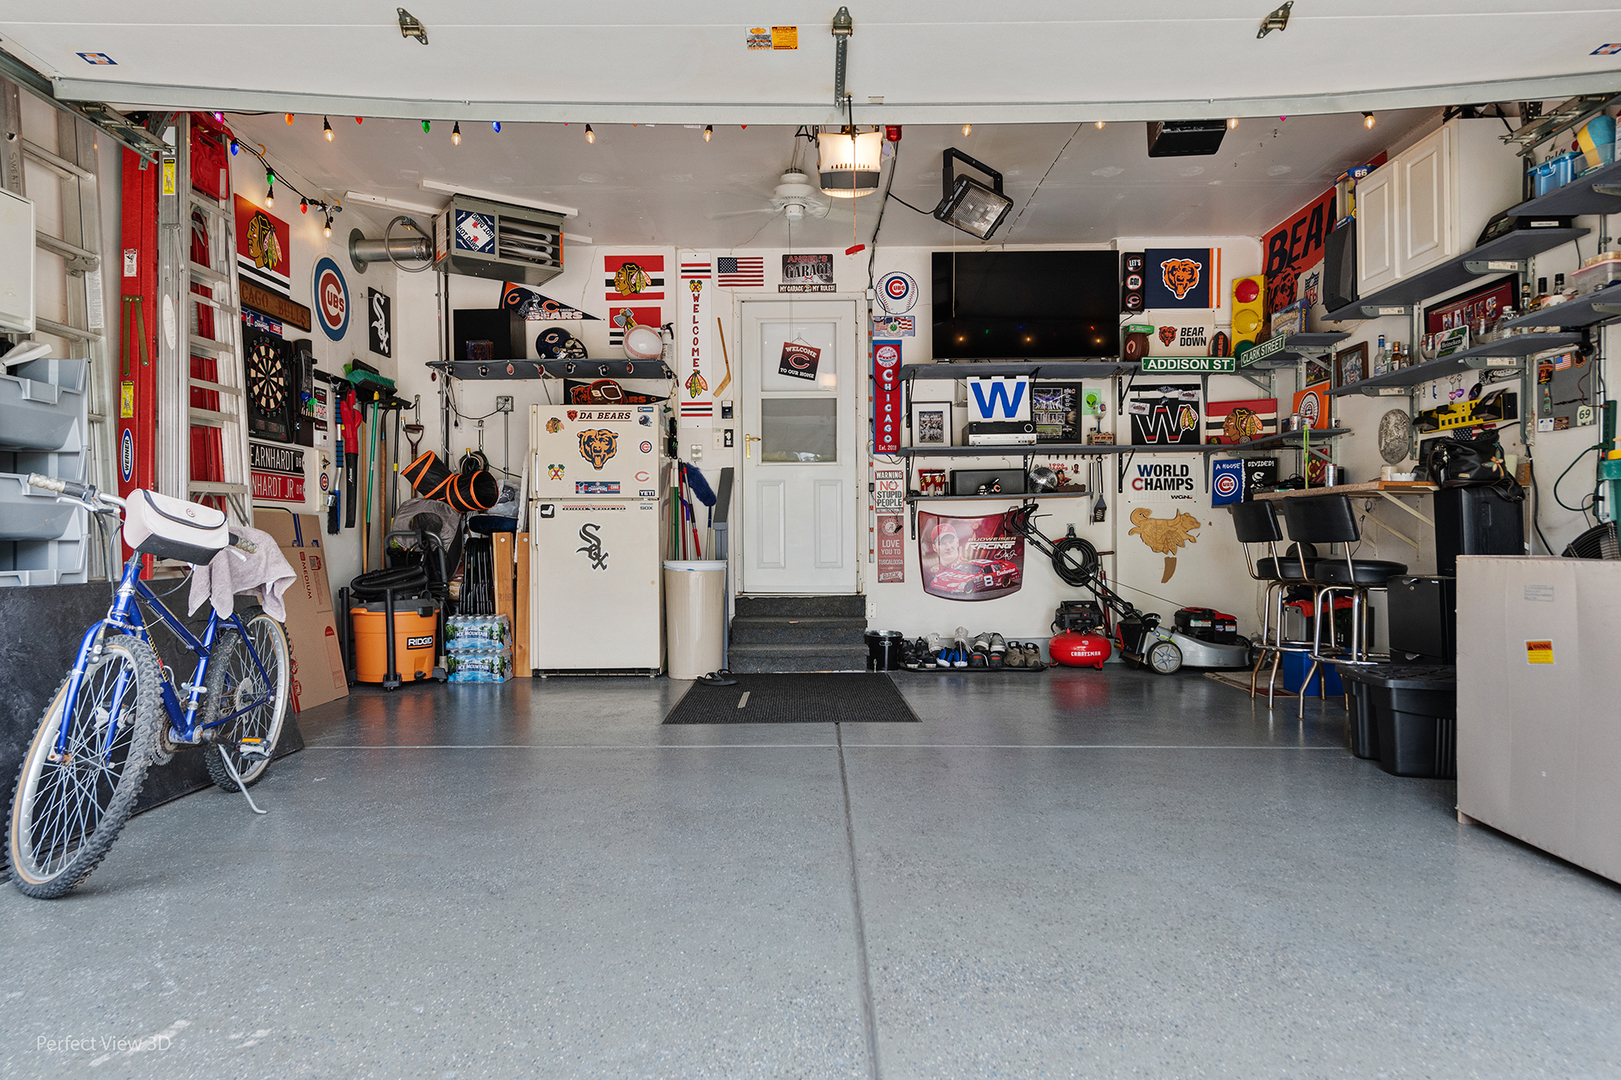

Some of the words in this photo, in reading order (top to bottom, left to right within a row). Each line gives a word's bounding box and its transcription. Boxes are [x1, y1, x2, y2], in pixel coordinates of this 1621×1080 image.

[1355, 169, 1368, 177] 66
[457, 226, 469, 238] HOT
[787, 255, 828, 263] ANGEL'S
[1129, 259, 1141, 267] LET'S
[785, 263, 832, 279] GARAGE
[1129, 278, 1140, 286] GO!
[278, 300, 307, 328] BULLS
[692, 294, 700, 367] WELCOME
[1180, 327, 1205, 336] BEAR
[1180, 337, 1207, 347] DOWN
[785, 347, 817, 358] WELCOME
[1242, 346, 1261, 364] CLARK
[1261, 337, 1283, 356] STREET
[1147, 360, 1210, 370] ADDISON
[1213, 360, 1231, 370] ST
[970, 381, 1027, 419] W
[882, 369, 893, 443] CHICAGO
[579, 412, 593, 420] DA
[597, 412, 631, 420] BEARS
[1579, 408, 1591, 420] 69
[249, 444, 295, 471] EARNHARDT
[876, 471, 903, 479] WARNING
[1137, 464, 1189, 477] WORLD
[285, 478, 295, 499] JR
[880, 480, 898, 491] NO
[1132, 477, 1194, 491] CHAMPS
[876, 499, 903, 507] PEOPLE
[882, 540, 900, 548] LOVE
[965, 541, 1016, 550] RACING
[301, 560, 313, 600] MEDIUM
[984, 575, 994, 587] 8
[408, 636, 433, 646] RIDGID
